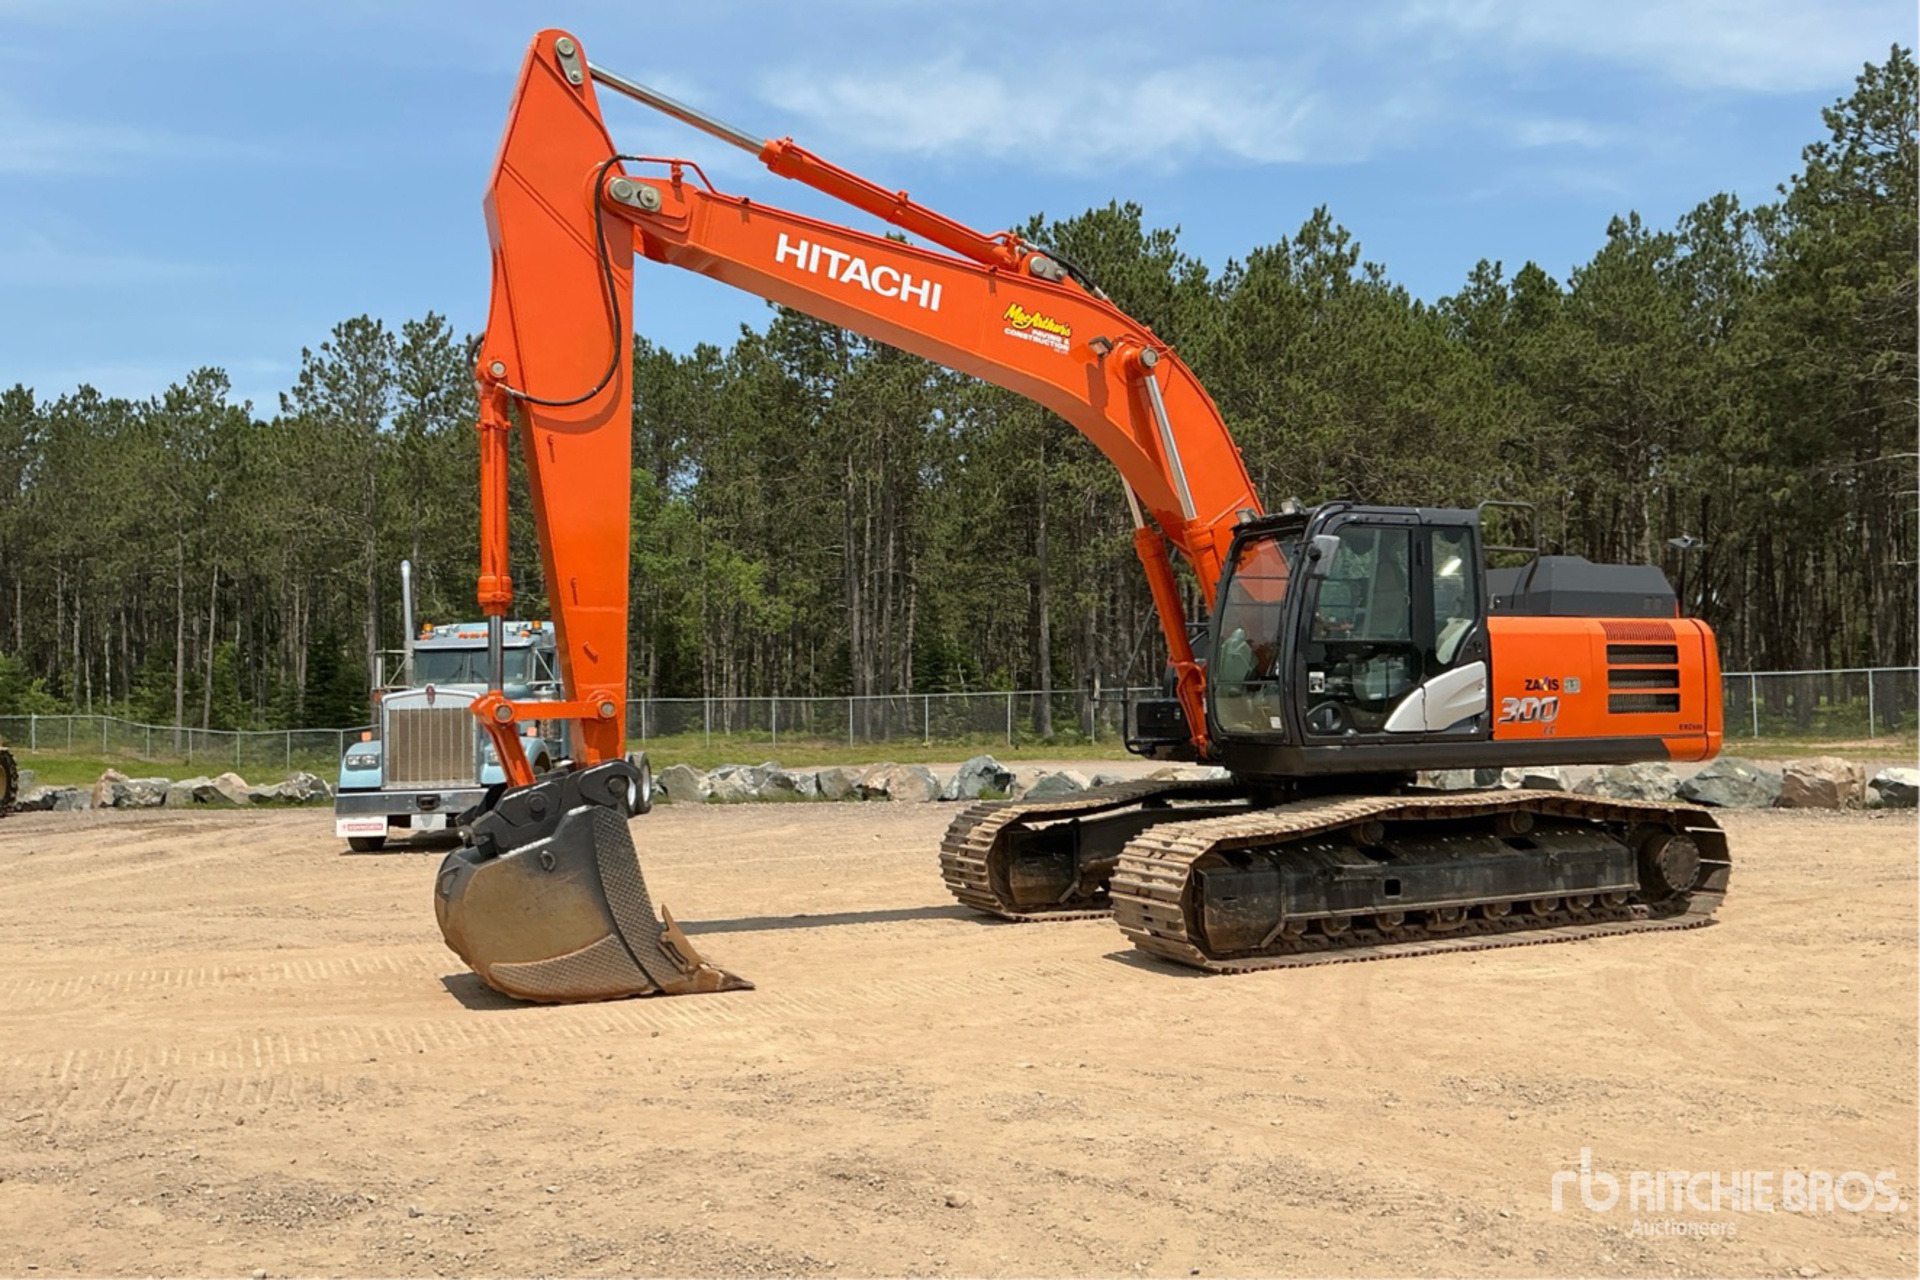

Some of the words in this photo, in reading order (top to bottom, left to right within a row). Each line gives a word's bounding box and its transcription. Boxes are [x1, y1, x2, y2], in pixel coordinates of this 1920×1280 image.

[775, 233, 943, 311] HITACHI
[1004, 328, 1069, 352] CONSTRUCTION
[1032, 329, 1062, 342] PAVING
[1525, 677, 1559, 691] ZAXIS
[1498, 696, 1560, 724] 300
